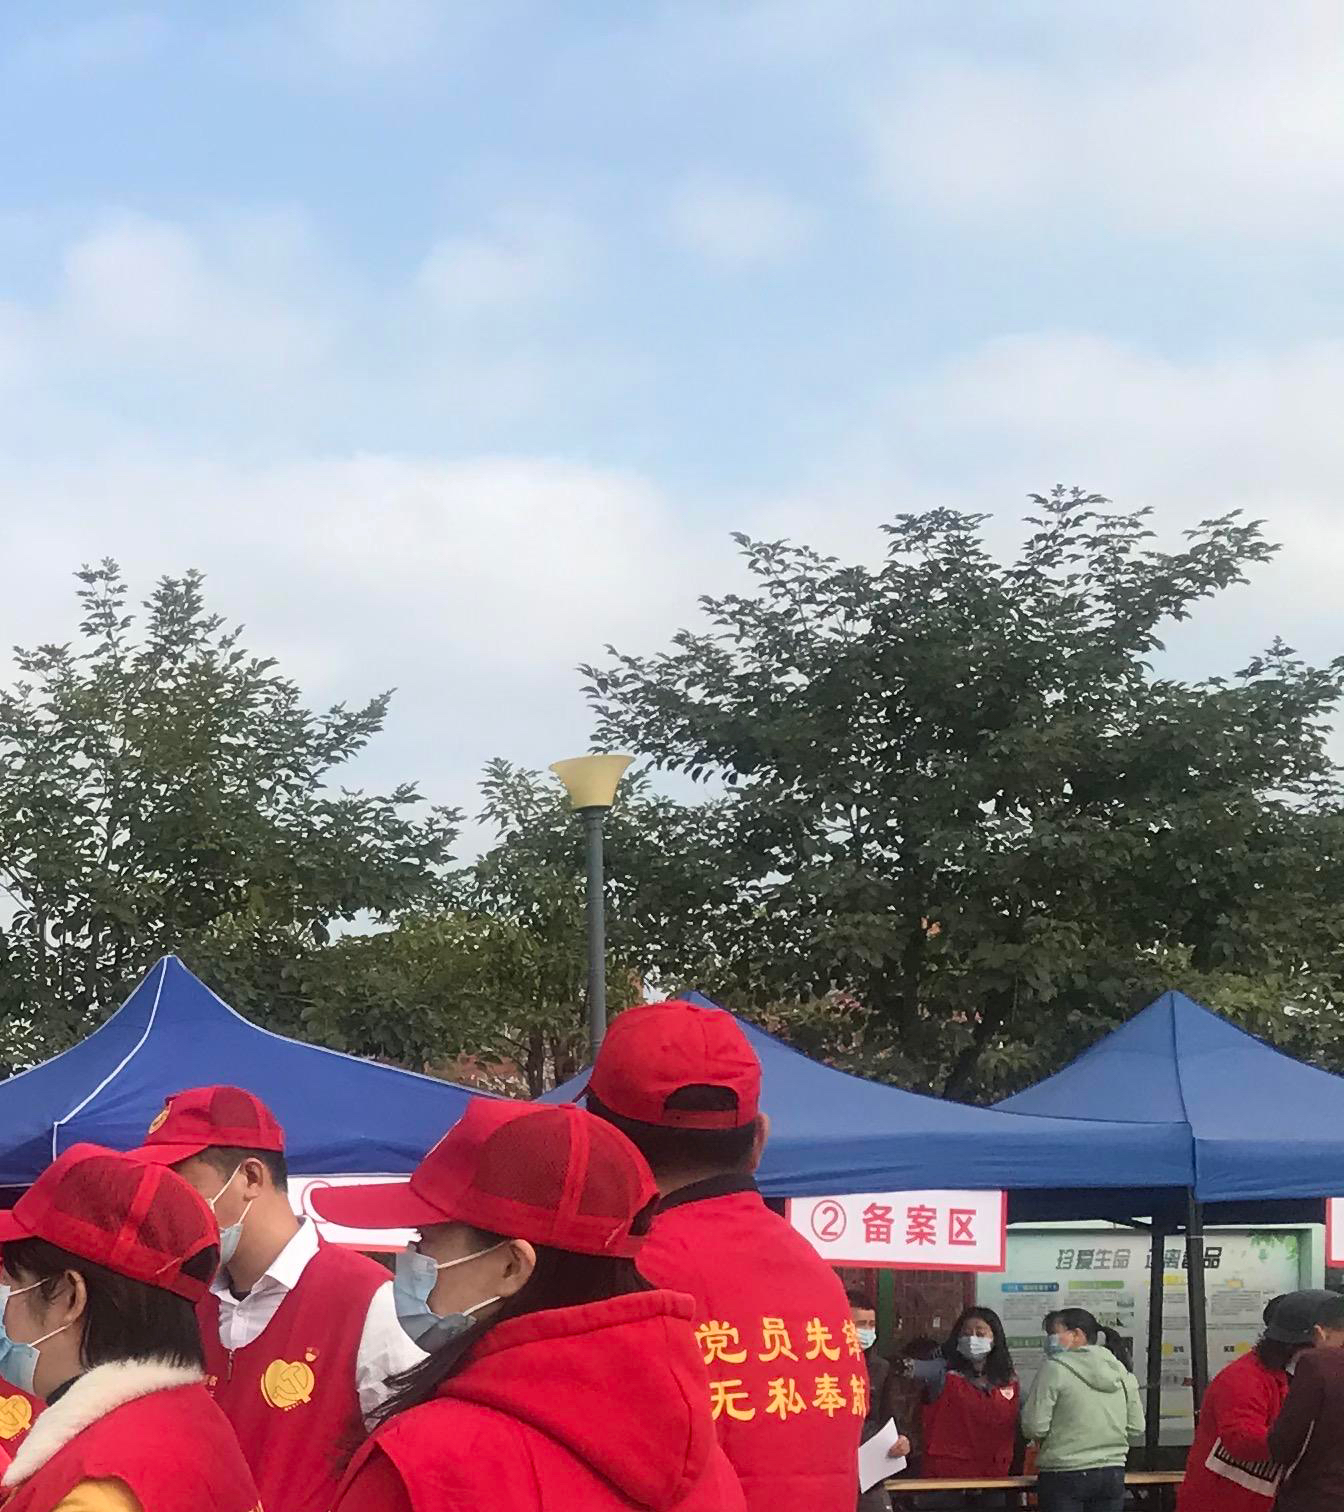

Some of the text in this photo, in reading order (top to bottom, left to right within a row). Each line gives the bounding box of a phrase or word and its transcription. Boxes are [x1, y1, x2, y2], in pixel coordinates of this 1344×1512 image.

[1055, 1246, 1223, 1271] 珍爱生命 离品
